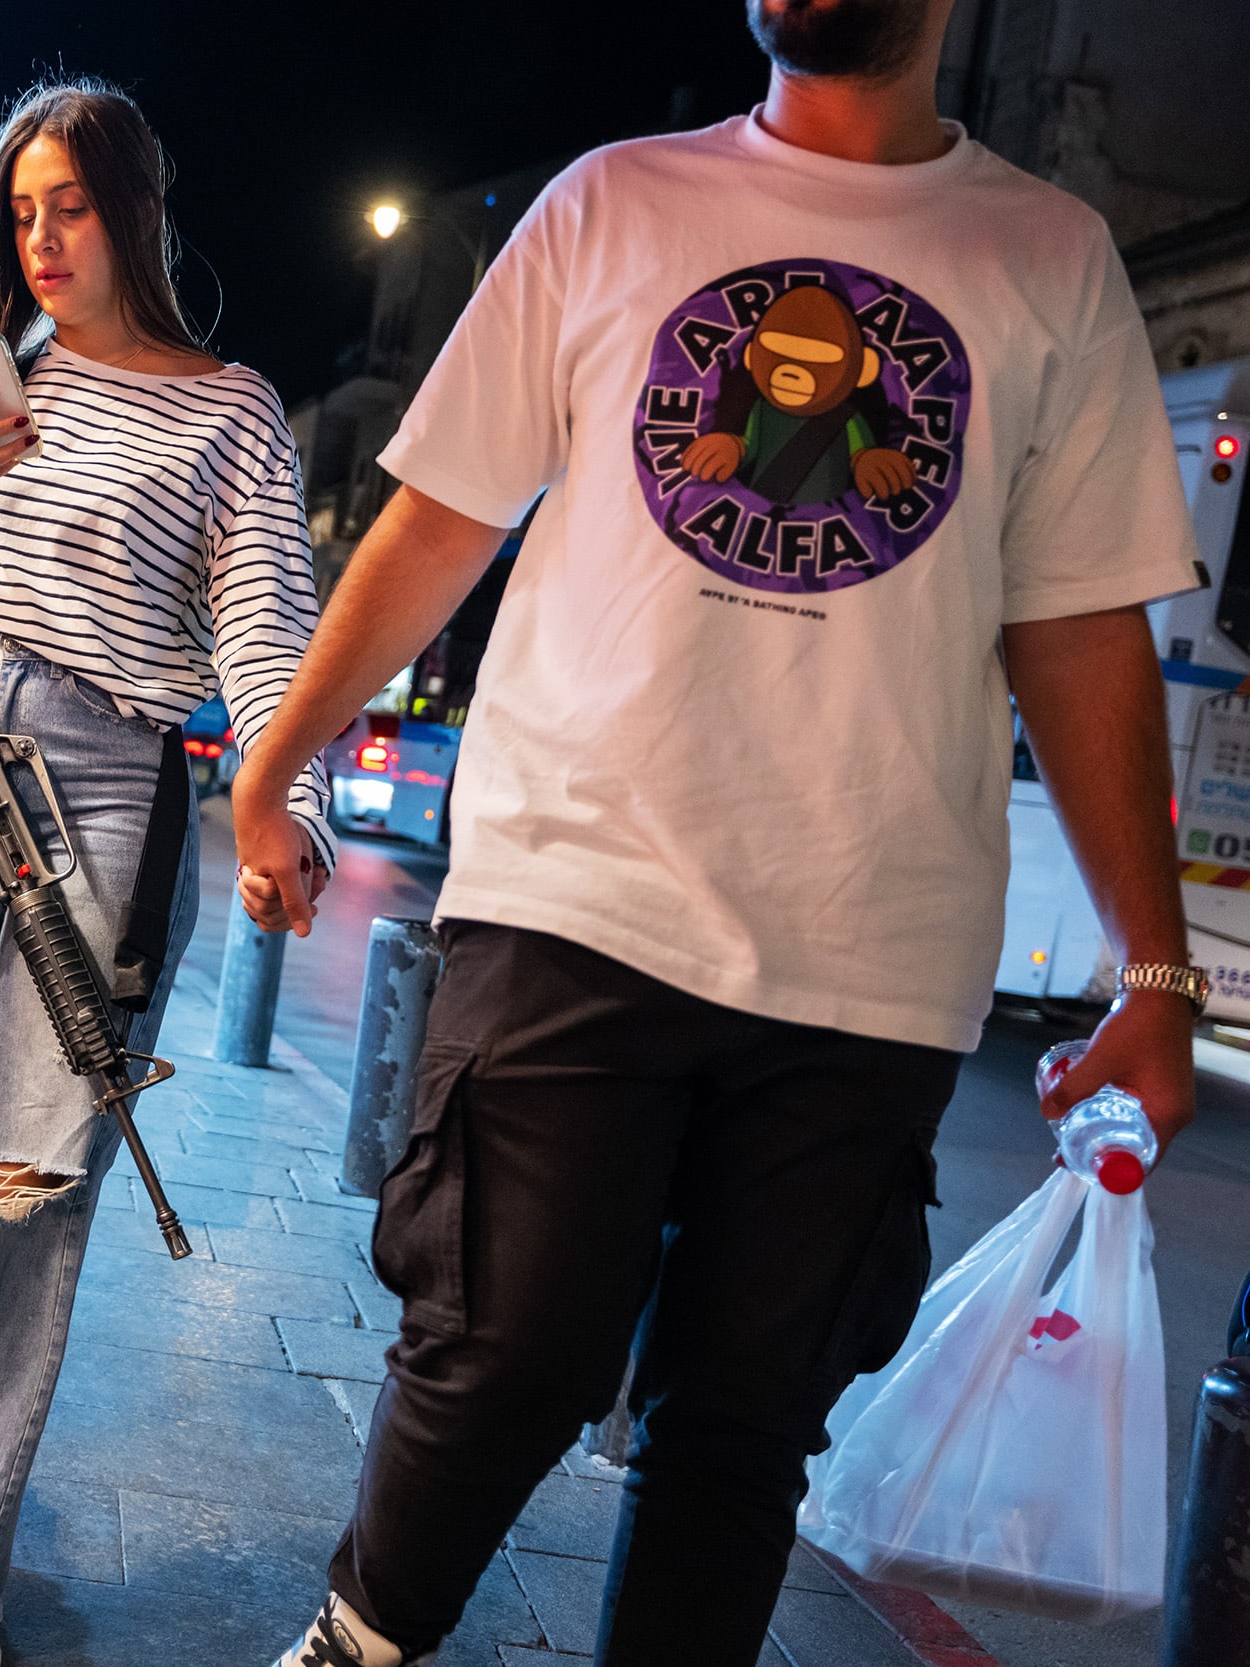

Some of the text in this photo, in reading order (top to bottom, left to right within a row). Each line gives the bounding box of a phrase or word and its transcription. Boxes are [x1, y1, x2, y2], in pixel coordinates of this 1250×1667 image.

[646, 385, 702, 499] WE
[857, 294, 958, 533] AAPER
[681, 495, 874, 578] ALFA
[753, 600, 797, 615] BATHING
